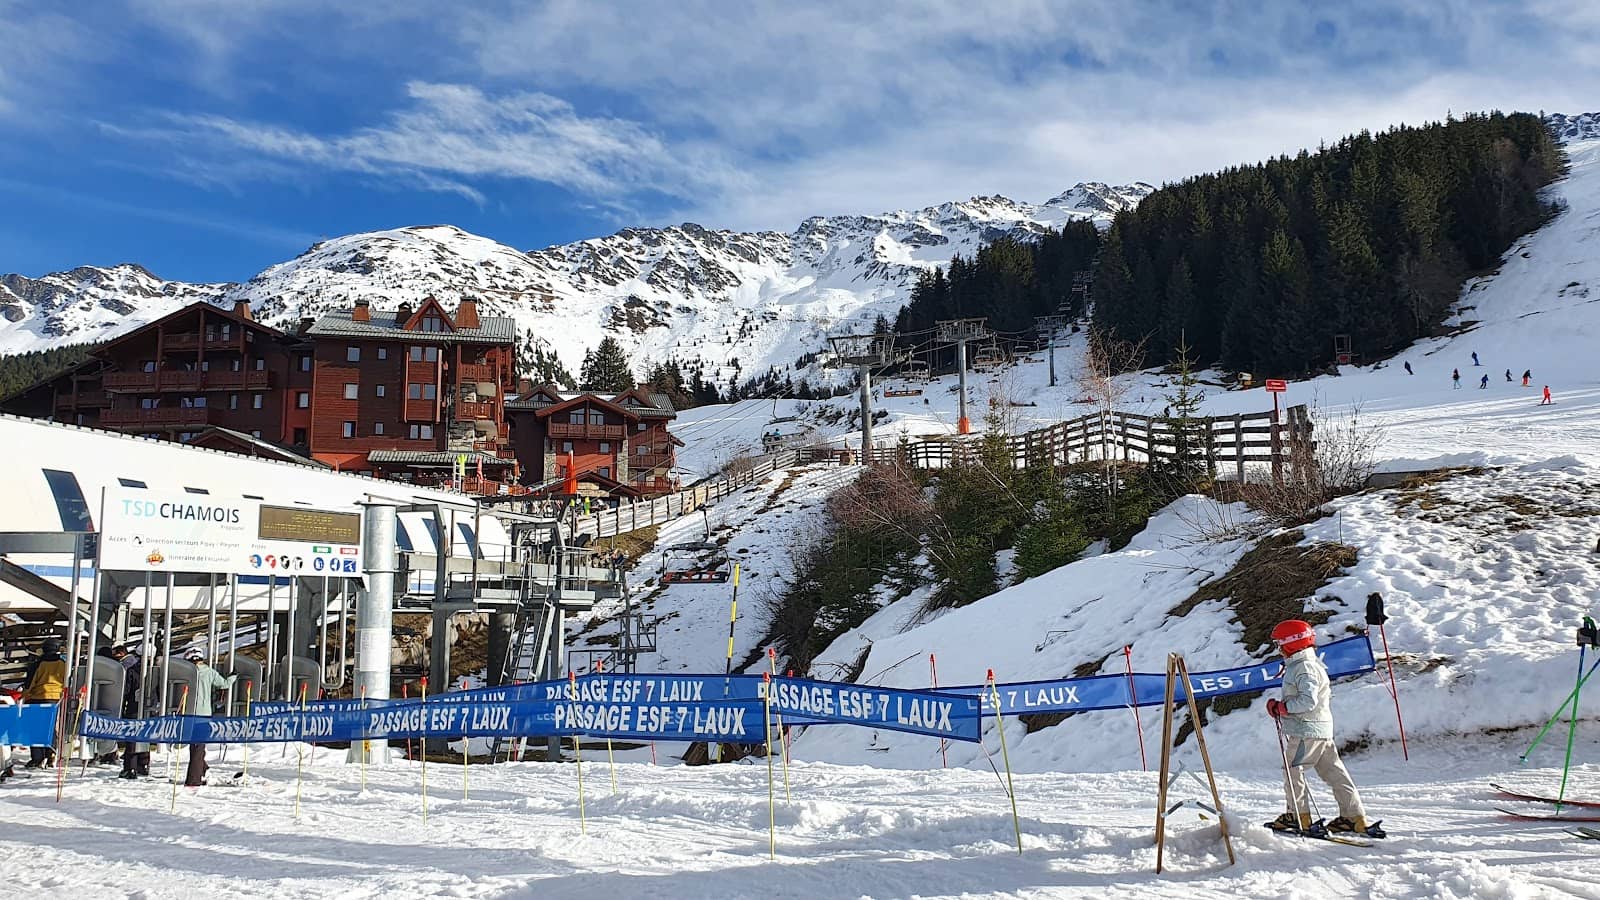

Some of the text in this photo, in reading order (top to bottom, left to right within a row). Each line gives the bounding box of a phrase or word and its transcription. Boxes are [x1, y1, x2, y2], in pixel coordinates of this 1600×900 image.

[122, 499, 240, 523] TSD CHAMOIS
[1240, 671, 1251, 685] 7
[546, 679, 704, 702] PASSAGE ESF 7 LAUX
[1007, 690, 1017, 708] 7
[1025, 685, 1080, 707] LAUX
[757, 682, 834, 715] PASSAGE
[839, 689, 873, 719] ESF
[879, 694, 889, 721] 7
[898, 696, 952, 732] LAUX
[86, 714, 179, 739] PASSAGE ESF 7 LAUX
[210, 716, 333, 738] PASSAGE ESF 7 LAUX
[369, 706, 511, 733] PASSAGE ESF 7 LAUX
[555, 704, 632, 731] PASSAGE
[636, 706, 671, 733] ESF
[677, 706, 688, 733] 7
[694, 707, 746, 736] LAUX
